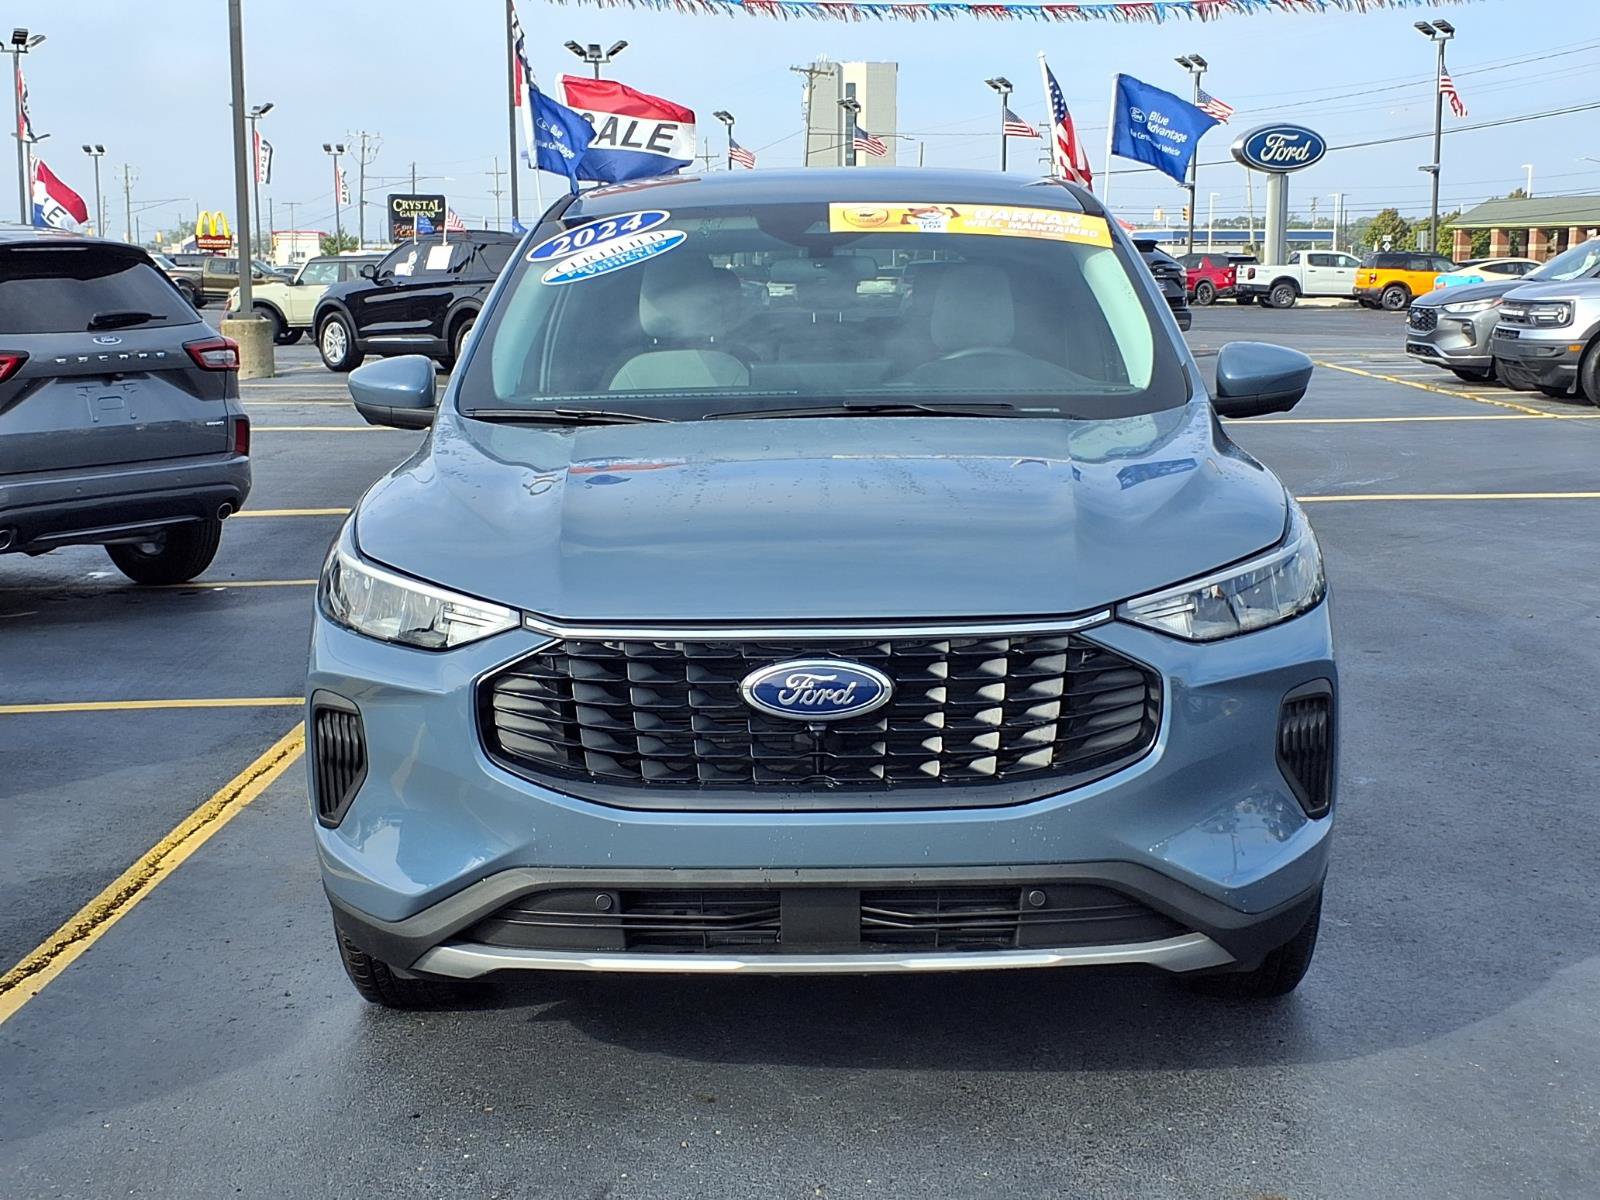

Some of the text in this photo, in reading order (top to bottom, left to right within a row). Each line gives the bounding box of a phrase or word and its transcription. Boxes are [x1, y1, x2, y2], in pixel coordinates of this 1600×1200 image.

[1149, 111, 1170, 126] Blue
[1147, 121, 1188, 143] Advantage
[1260, 133, 1311, 161] Ford
[393, 198, 443, 212] CRYSTAL
[975, 208, 1082, 227] CARFAX
[551, 213, 643, 254] 2024
[778, 673, 857, 705] Ford
